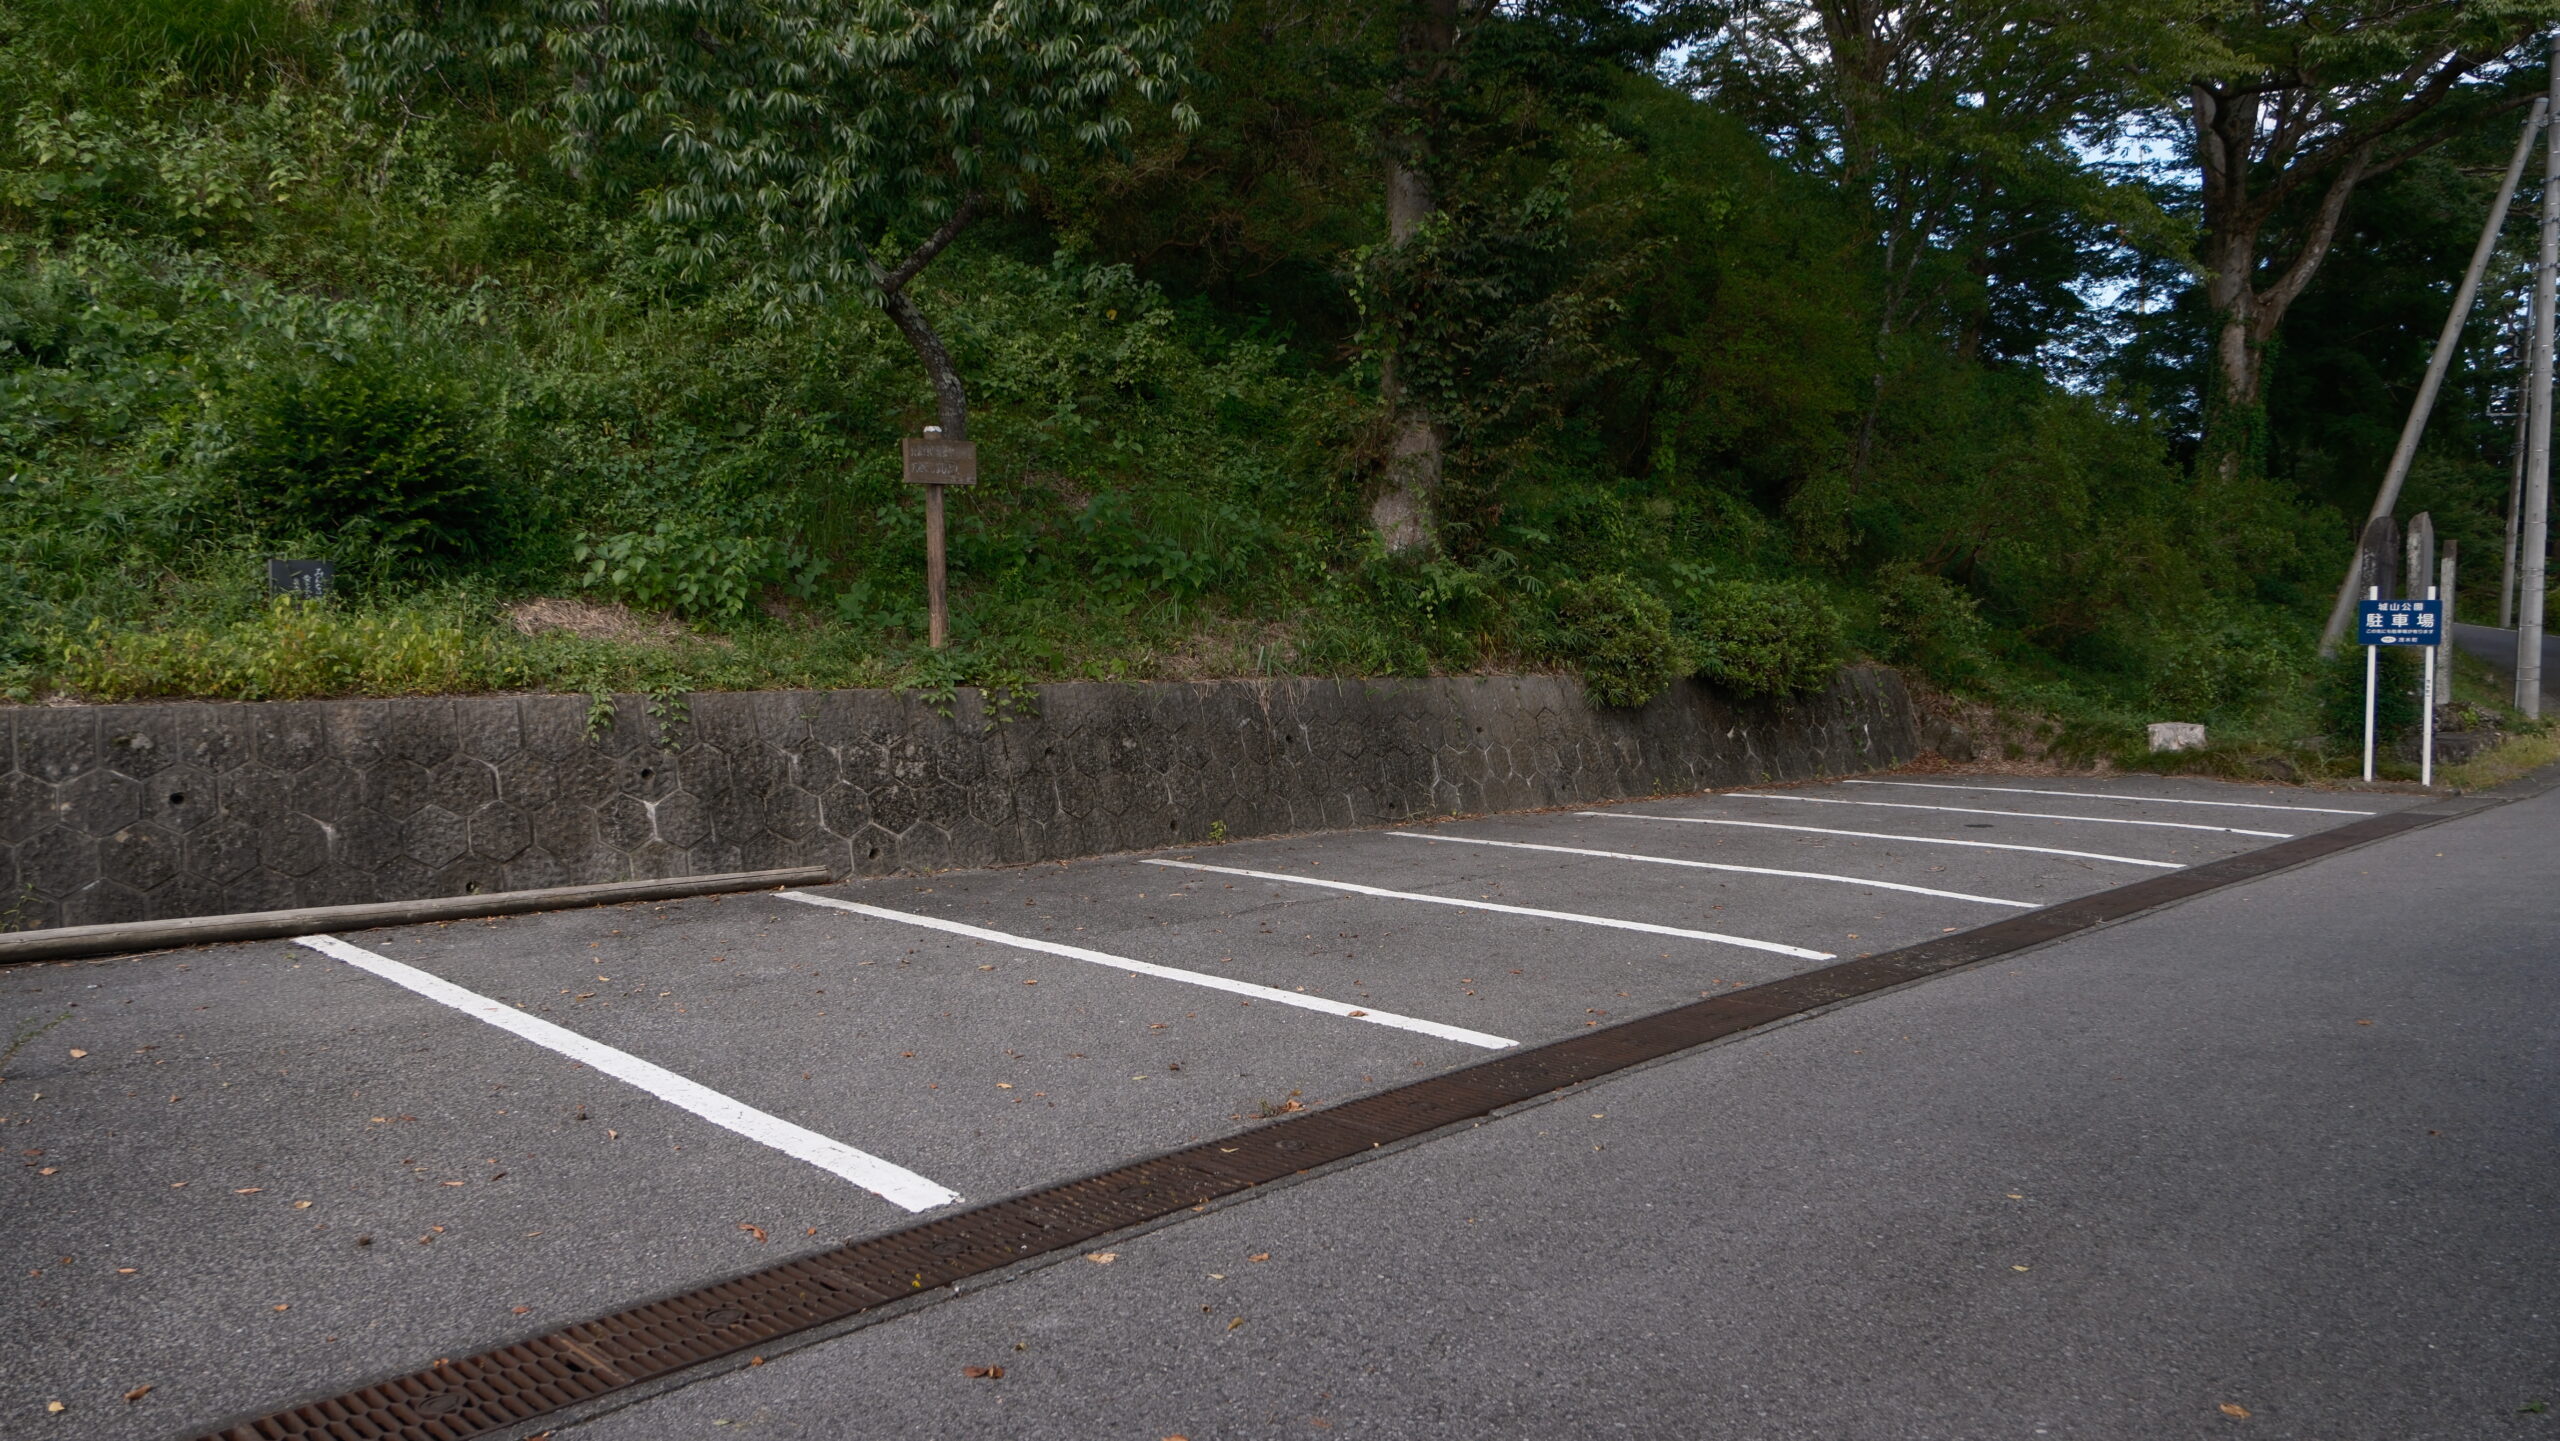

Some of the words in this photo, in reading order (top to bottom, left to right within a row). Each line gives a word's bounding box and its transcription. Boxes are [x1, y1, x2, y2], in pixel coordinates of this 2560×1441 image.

[2378, 603, 2424, 611] 城山公園
[2366, 613, 2434, 628] 駐車場
